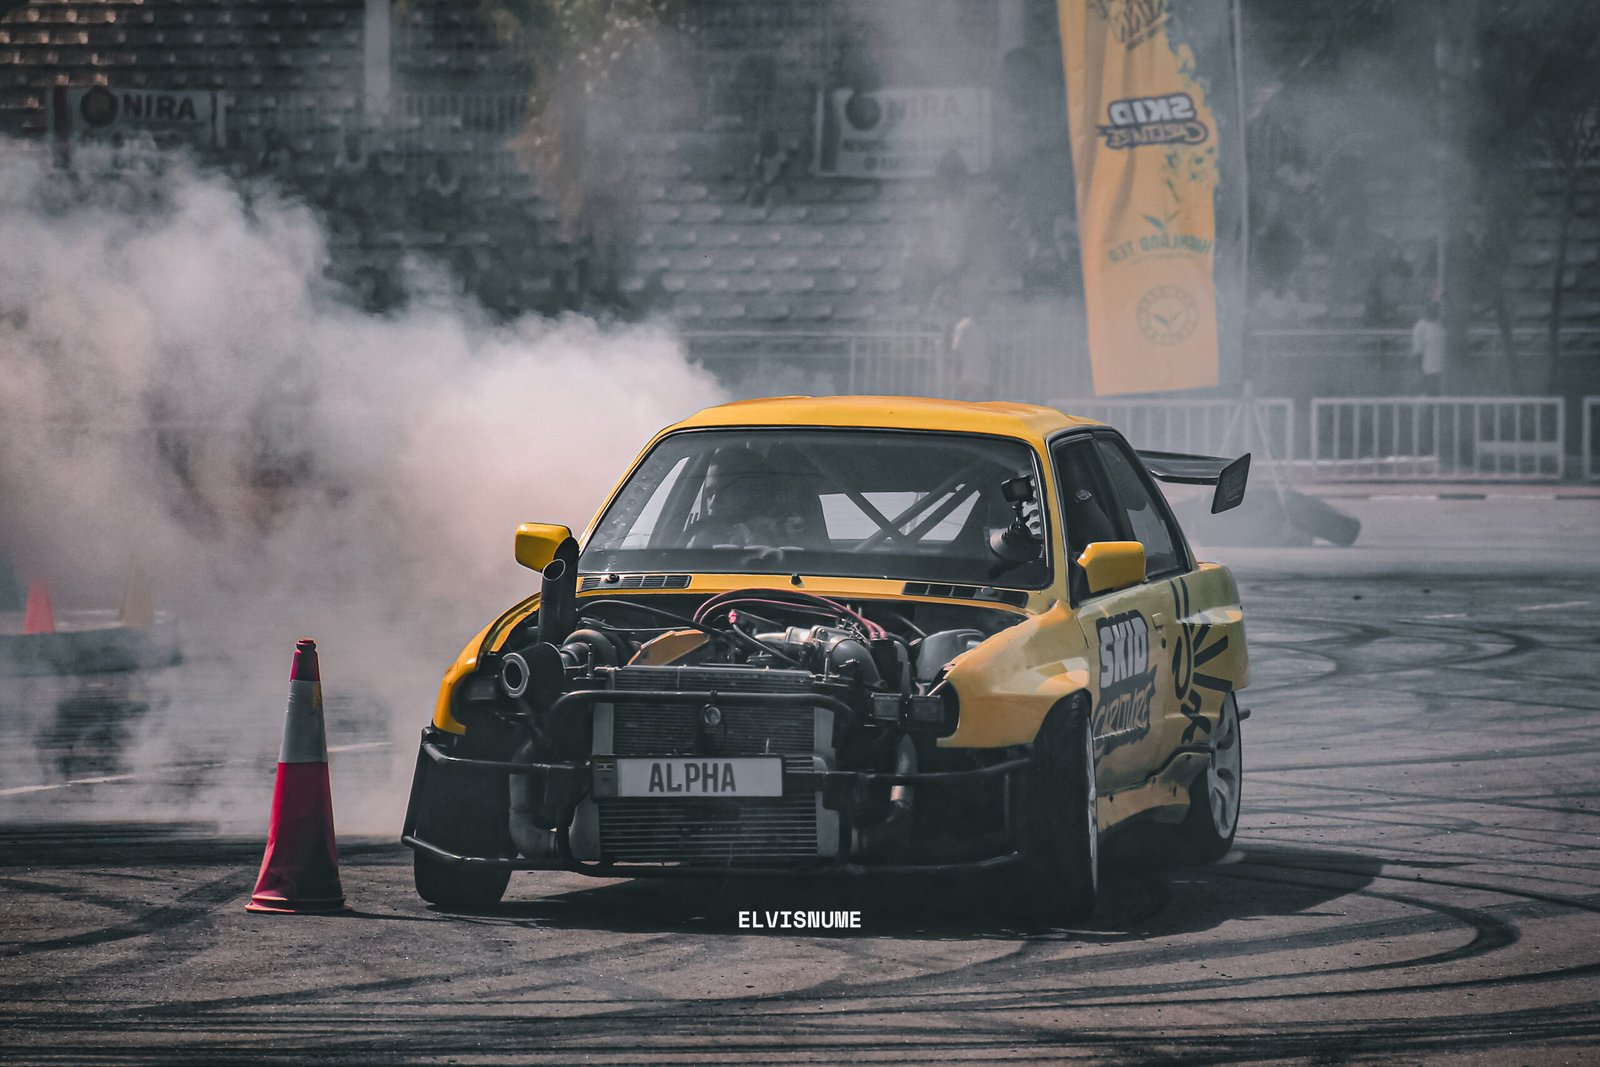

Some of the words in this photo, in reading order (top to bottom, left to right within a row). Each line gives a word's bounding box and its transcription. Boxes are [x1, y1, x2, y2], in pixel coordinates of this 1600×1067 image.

[123, 93, 197, 120] NIRA
[1098, 616, 1149, 690] SKID
[649, 762, 736, 793] ALPHA
